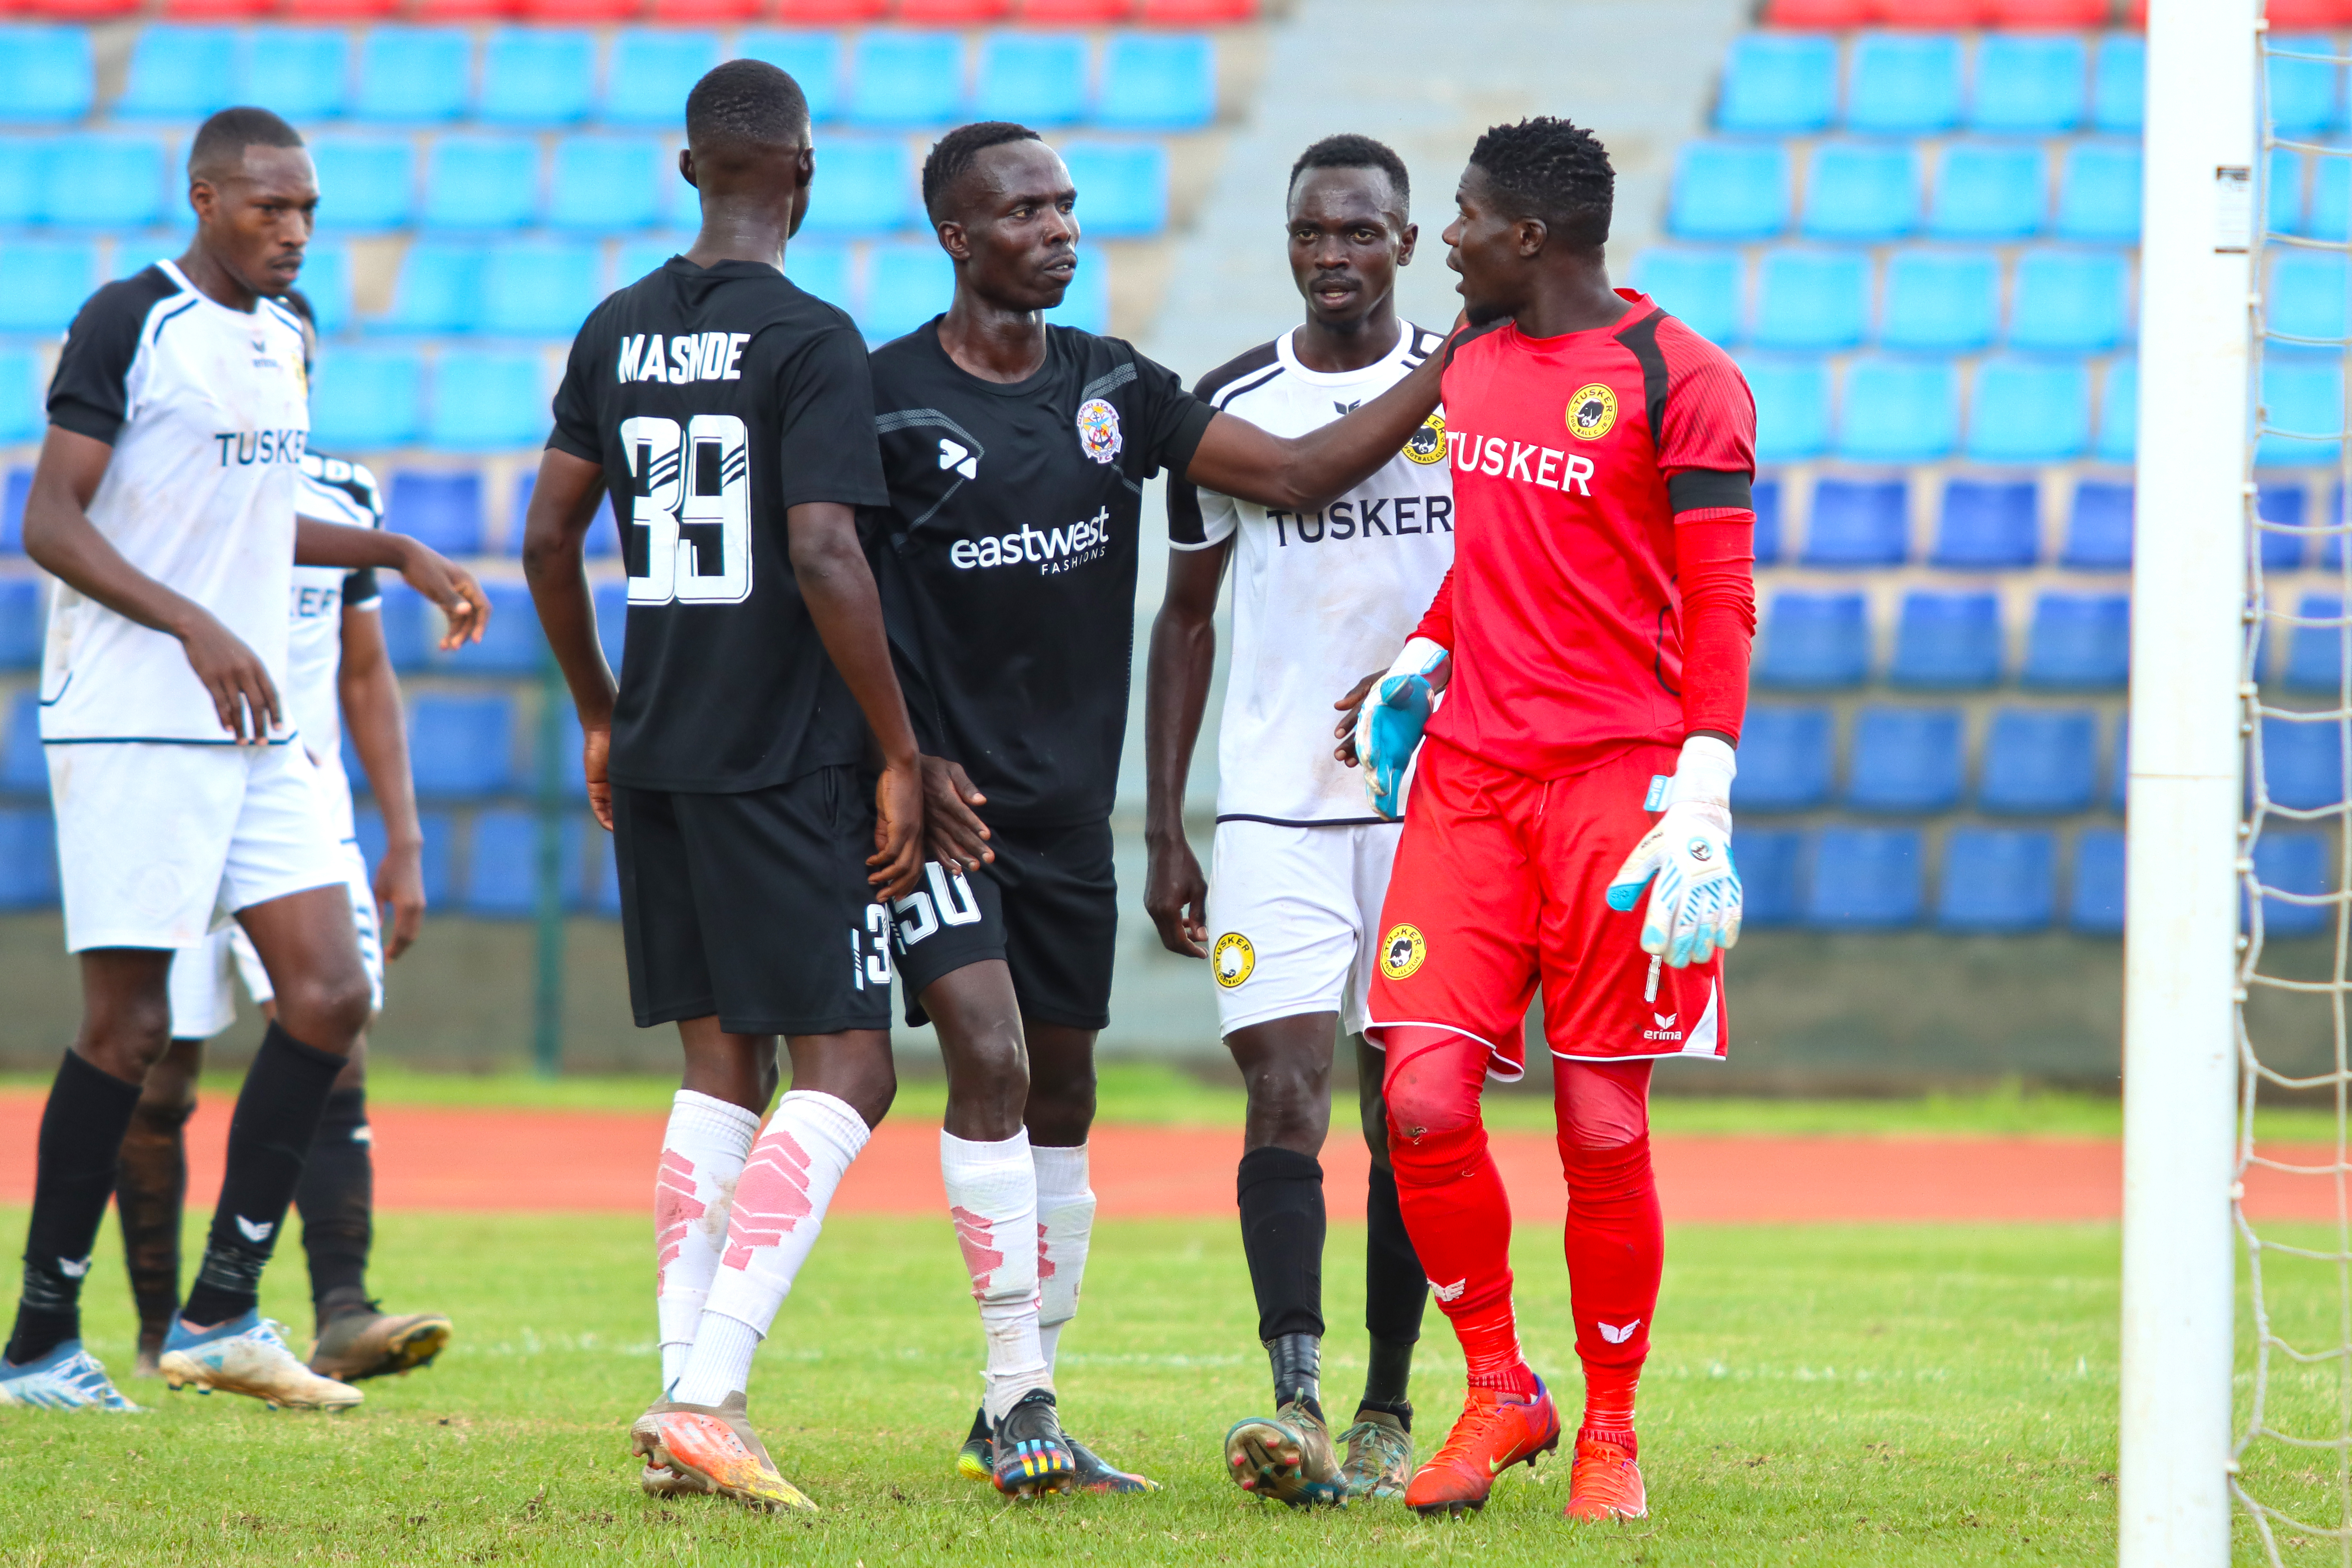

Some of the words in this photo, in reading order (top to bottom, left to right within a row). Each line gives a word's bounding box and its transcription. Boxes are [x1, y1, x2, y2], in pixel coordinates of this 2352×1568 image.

[1096, 402, 1117, 419] STARS
[1574, 389, 1613, 413] TUSKER
[1570, 415, 1592, 435] FOOBALL
[1404, 446, 1435, 462] FOOTBALL
[1445, 430, 1595, 497] TUSKER
[620, 414, 753, 606] 39
[1266, 495, 1455, 547] TUSKER
[951, 505, 1110, 569] eastwest
[1041, 546, 1106, 575] FASHIONS
[1216, 936, 1250, 964] TUSKER
[1408, 956, 1420, 969] CLUB
[1643, 1029, 1682, 1040] erima
